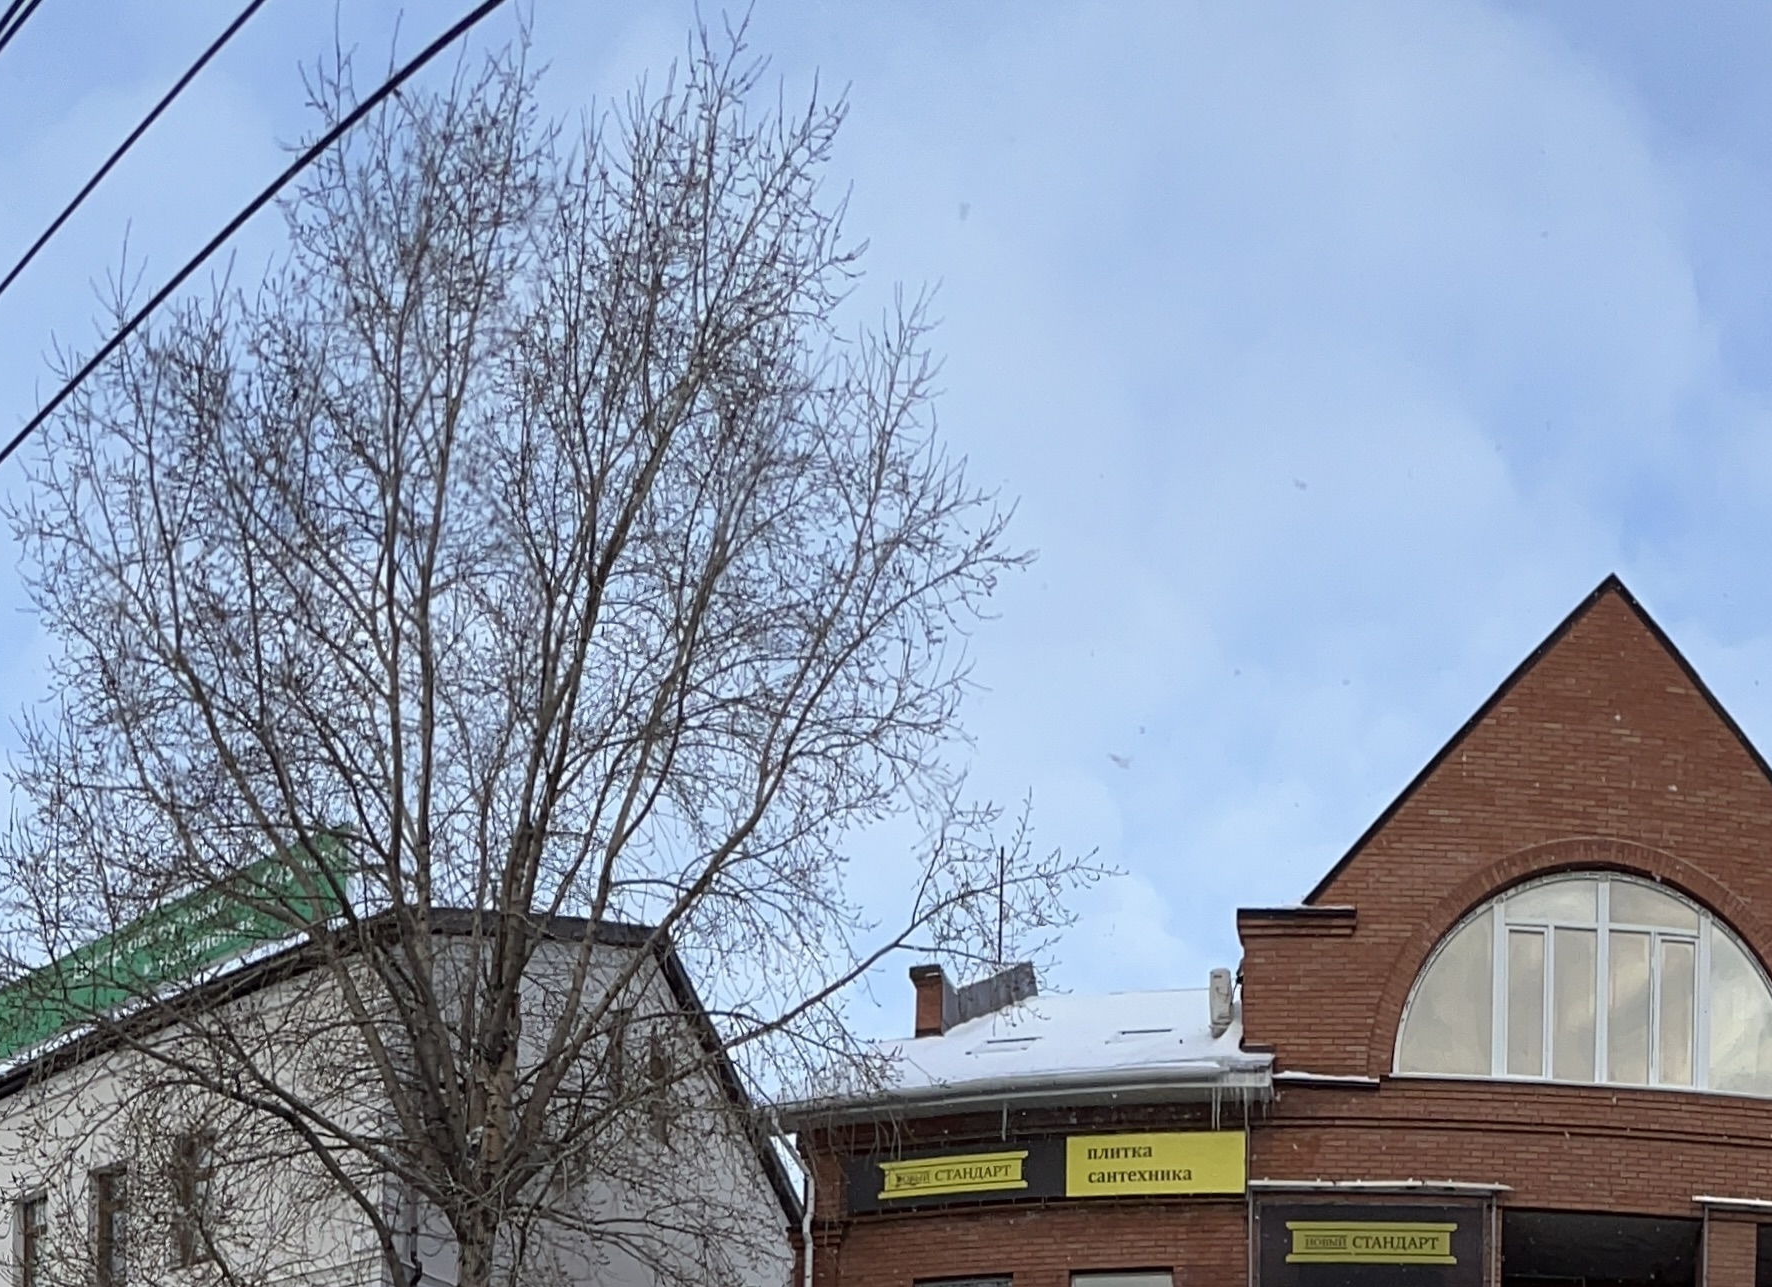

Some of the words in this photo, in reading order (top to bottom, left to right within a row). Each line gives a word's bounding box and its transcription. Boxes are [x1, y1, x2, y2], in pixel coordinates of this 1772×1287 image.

[1087, 1146, 1153, 1161] плитка
[935, 1165, 1011, 1182] СТАНДАРТ
[1088, 1169, 1193, 1183] сантехника
[1352, 1236, 1439, 1250] СТАНДАРТ
